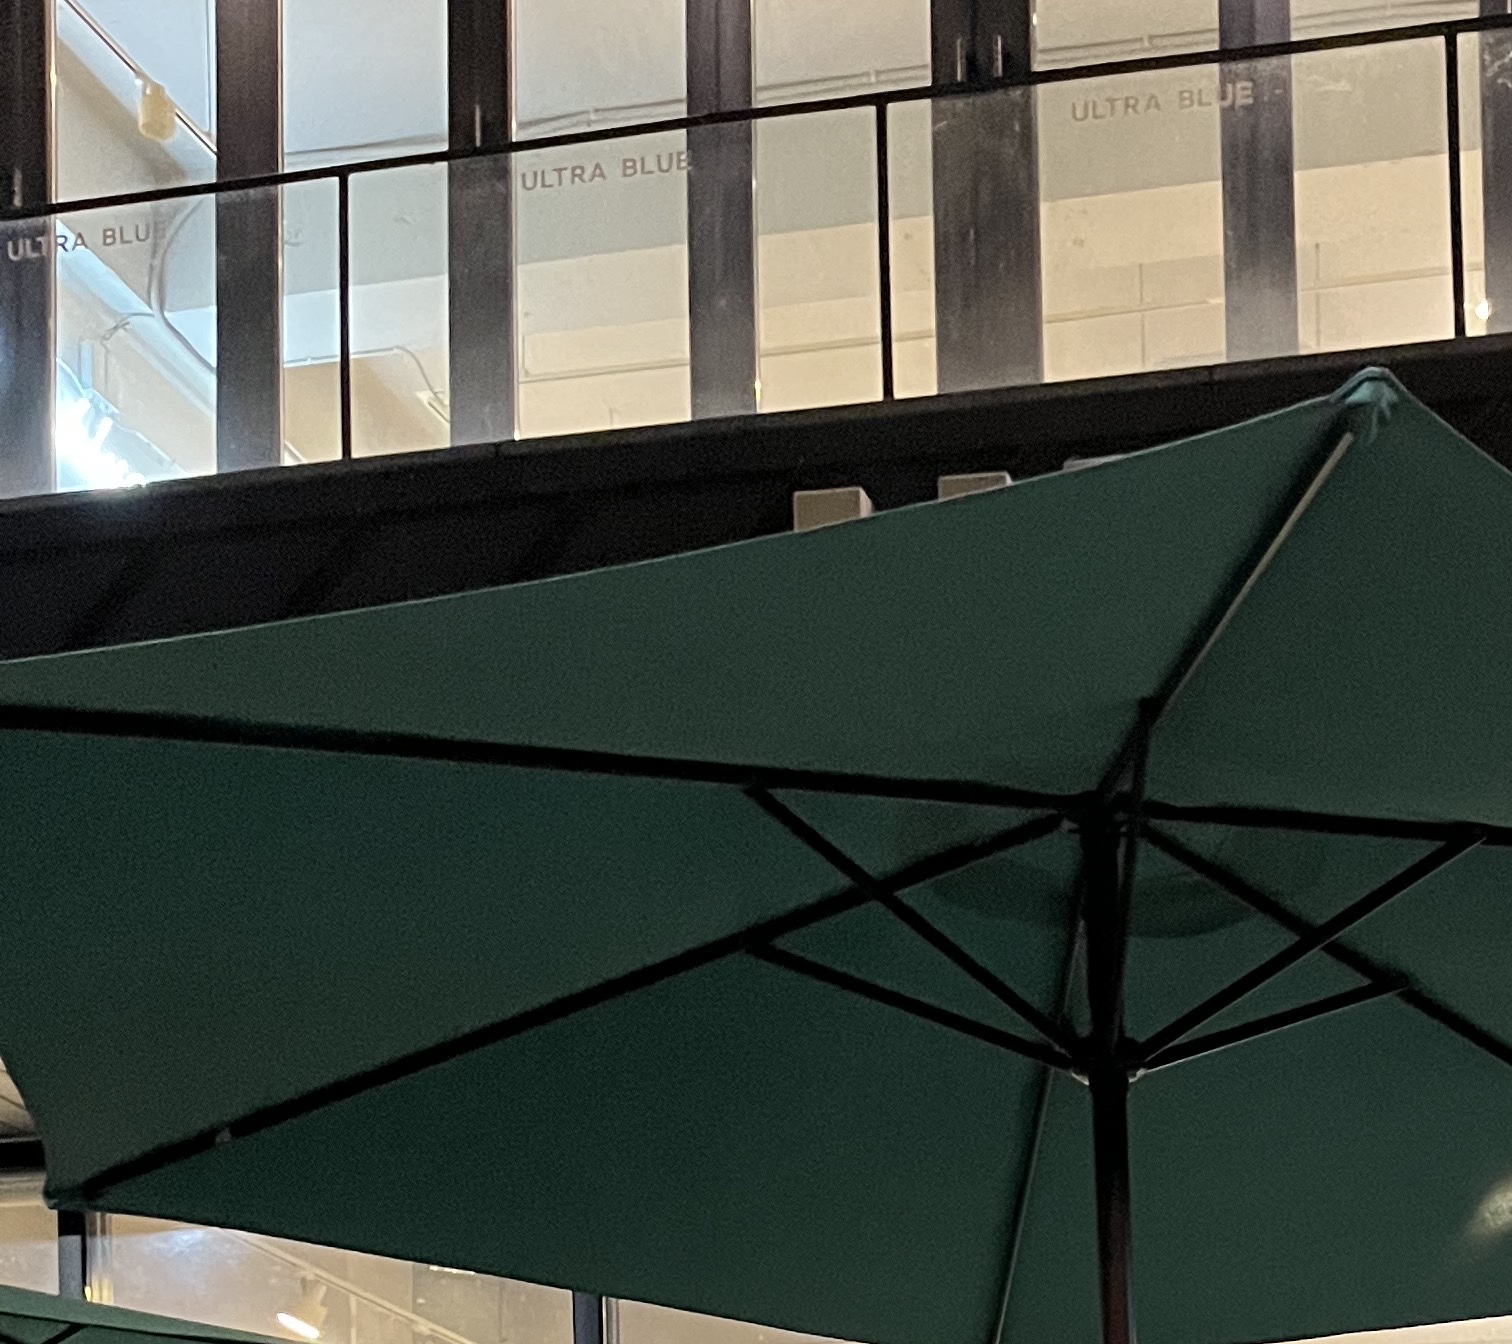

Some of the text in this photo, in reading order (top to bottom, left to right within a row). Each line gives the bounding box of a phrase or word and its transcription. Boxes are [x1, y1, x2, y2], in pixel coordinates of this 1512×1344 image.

[1071, 80, 1254, 122] ULTRA BLUE
[521, 150, 692, 191] ULTRA BLUE
[7, 232, 88, 261] ULTRA
